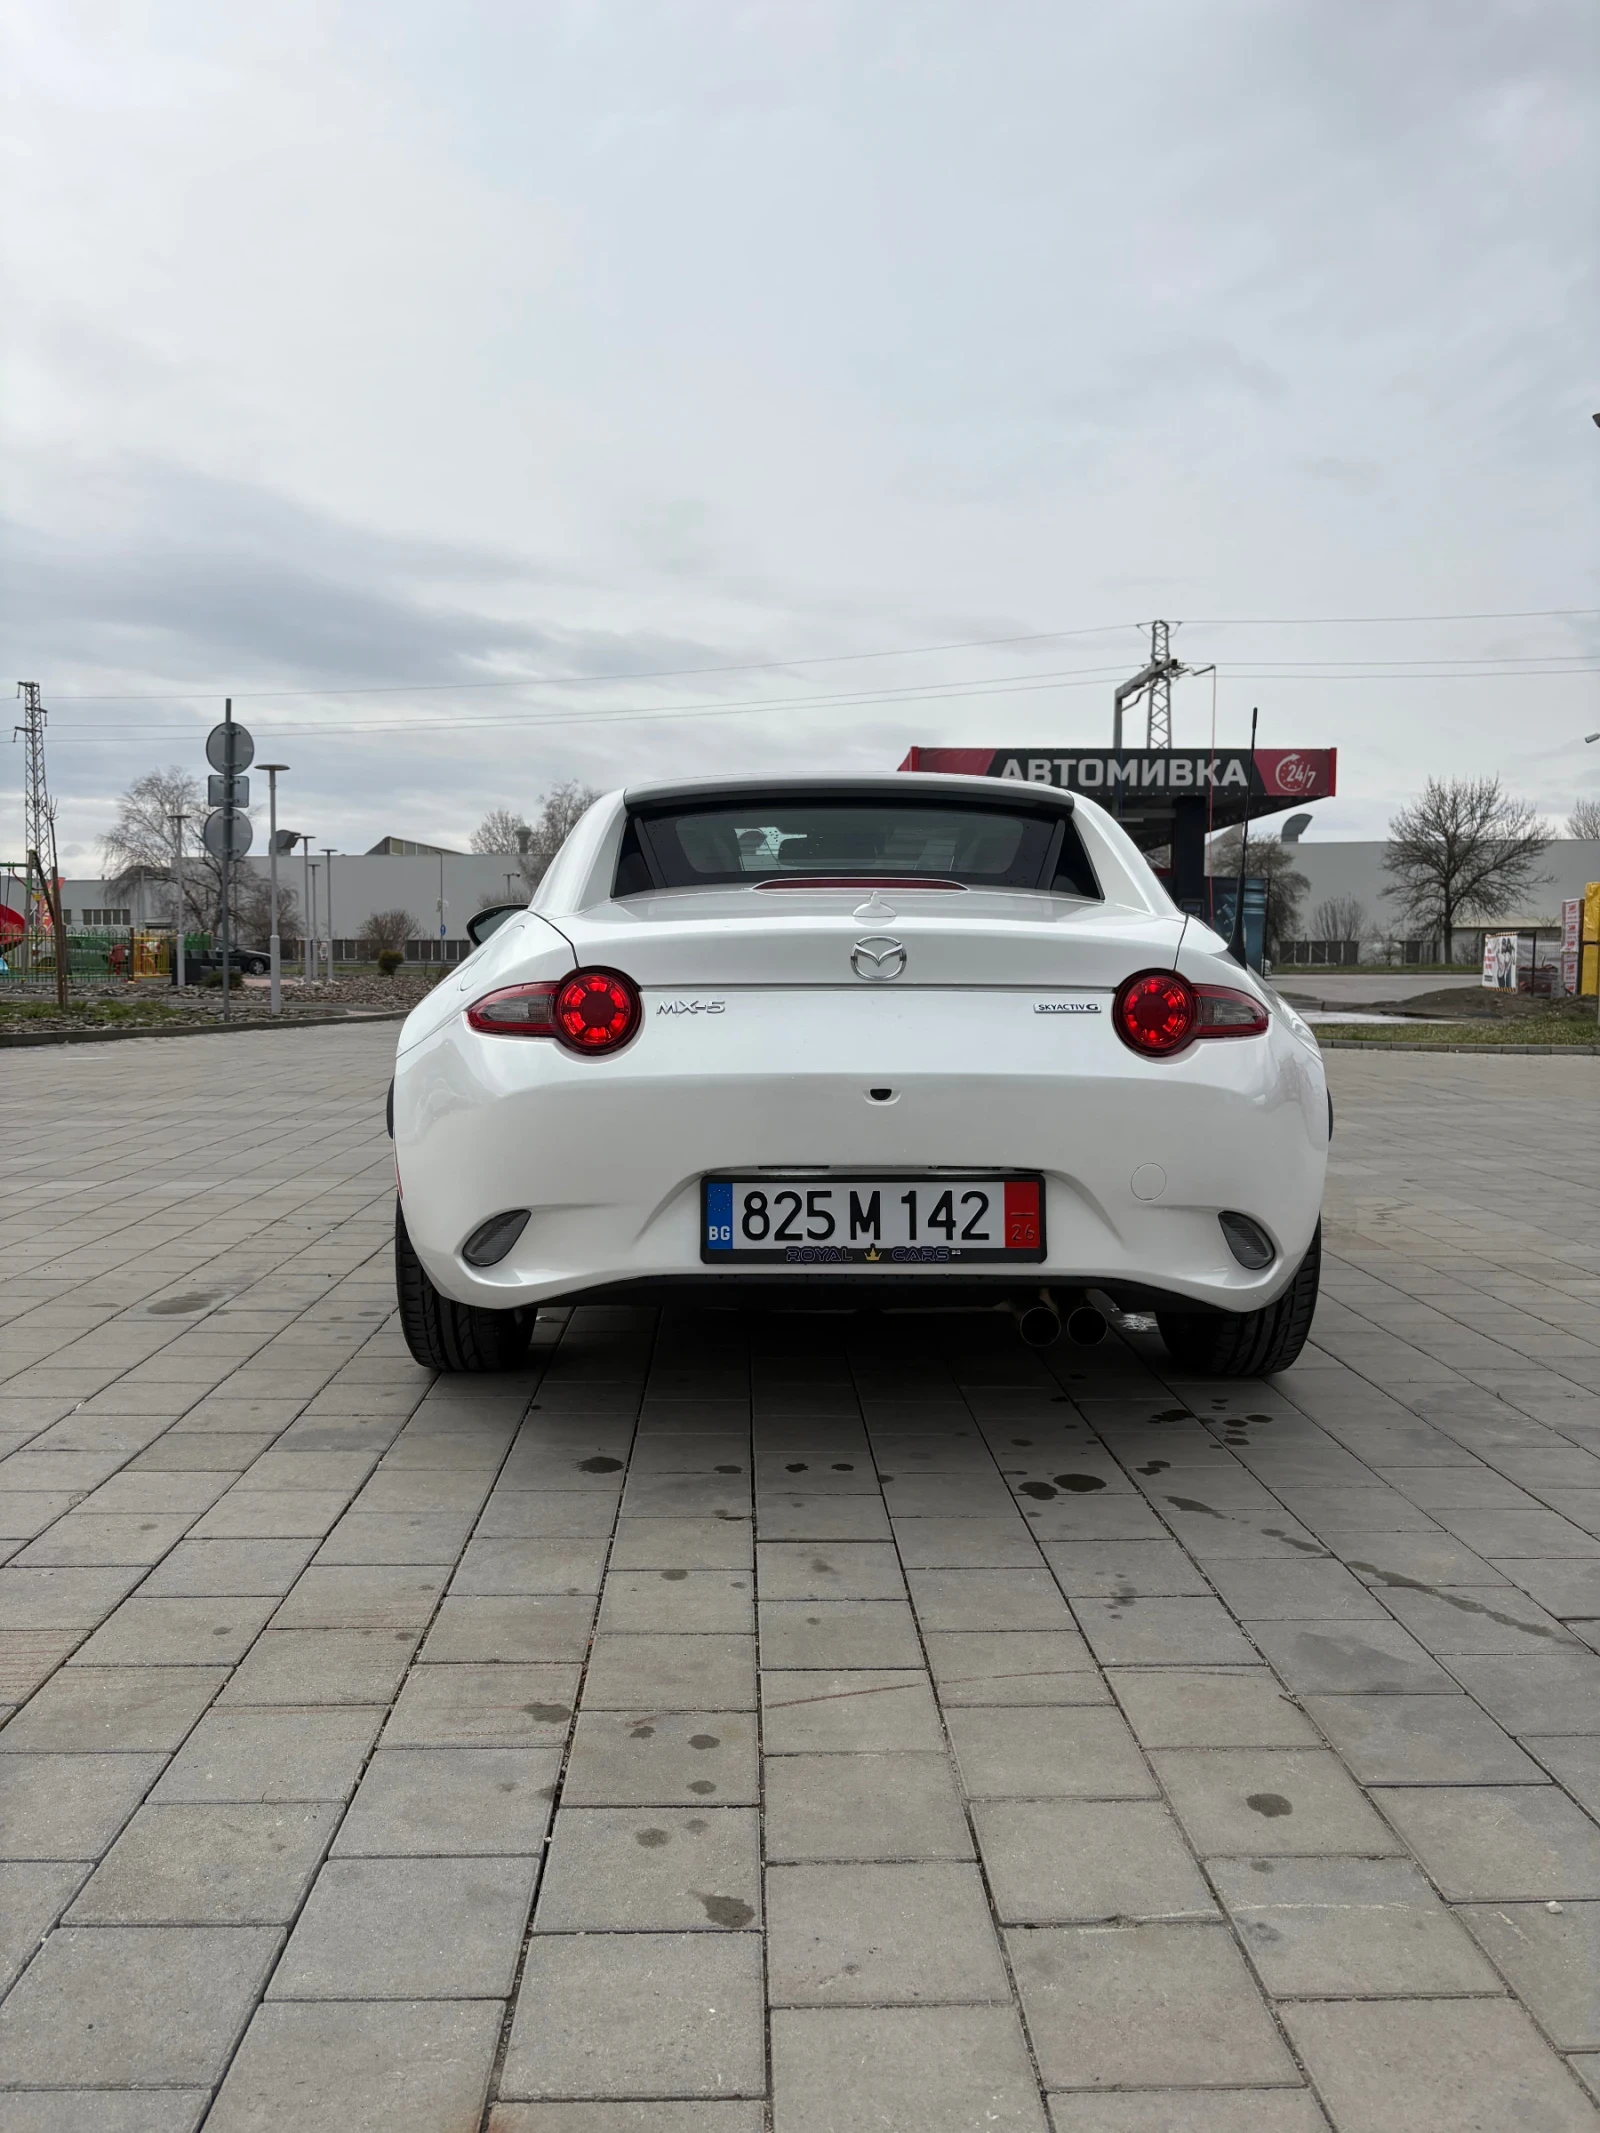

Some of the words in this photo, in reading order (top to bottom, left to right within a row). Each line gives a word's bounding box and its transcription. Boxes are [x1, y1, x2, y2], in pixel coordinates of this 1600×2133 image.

[1000, 758, 1249, 787] АВТОМИВКА
[1286, 764, 1317, 789] 24/7
[656, 1000, 726, 1016] MX-5
[741, 1190, 836, 1242] 825
[849, 1190, 881, 1241] M
[900, 1190, 990, 1241] 142
[708, 1225, 731, 1241] BG
[1011, 1223, 1036, 1242] 26
[785, 1246, 853, 1262] ROYAL
[891, 1246, 950, 1262] CARS
